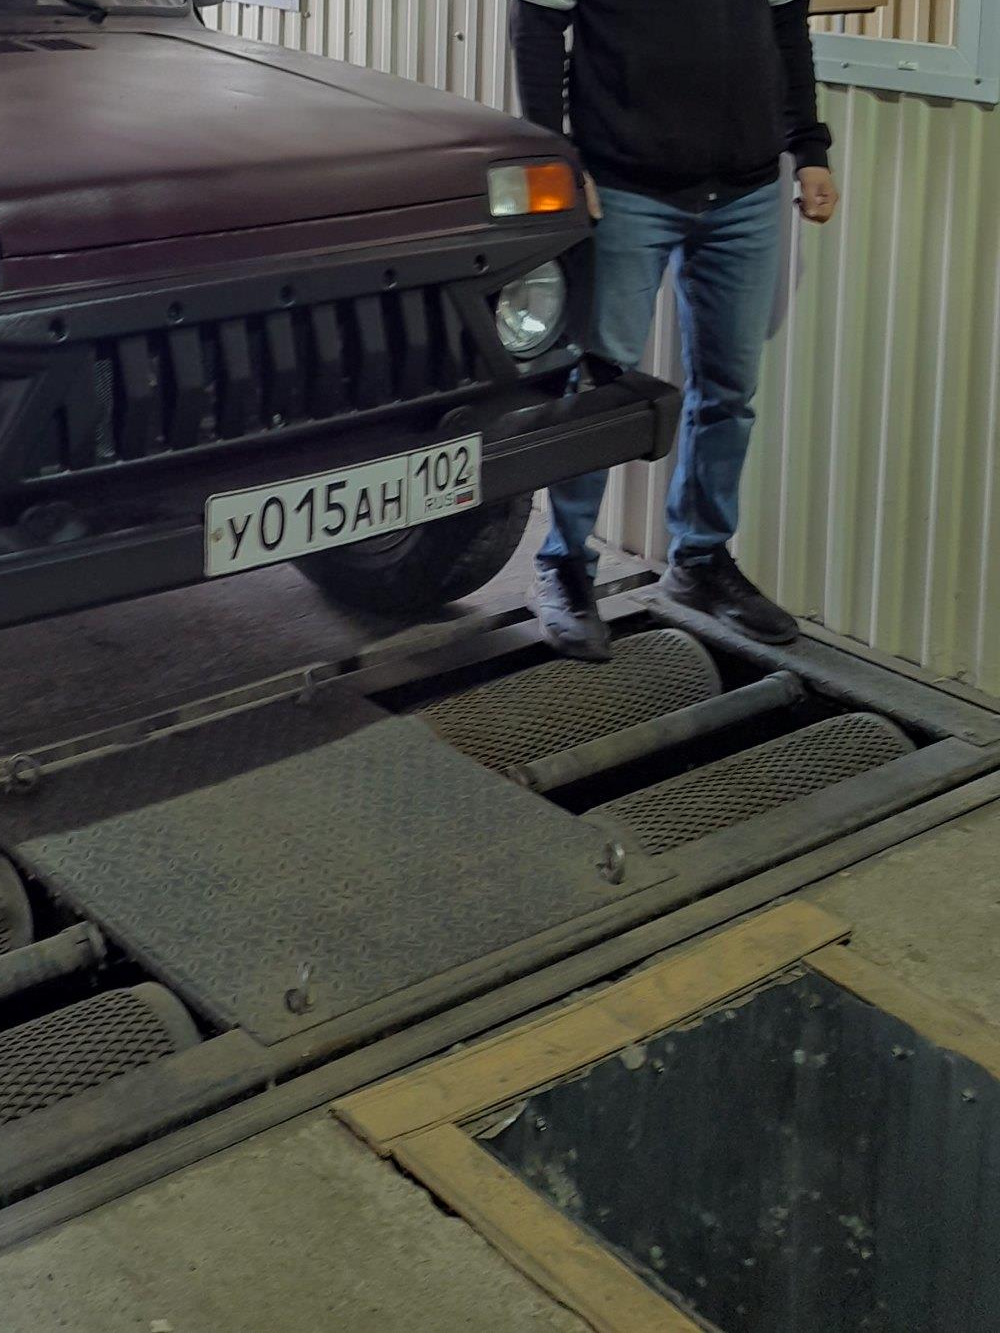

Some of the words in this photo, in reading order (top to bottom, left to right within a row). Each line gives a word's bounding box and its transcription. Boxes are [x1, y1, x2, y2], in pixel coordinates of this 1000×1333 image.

[227, 478, 404, 560] У015АН
[415, 446, 473, 496] 102
[424, 490, 456, 513] RUS
